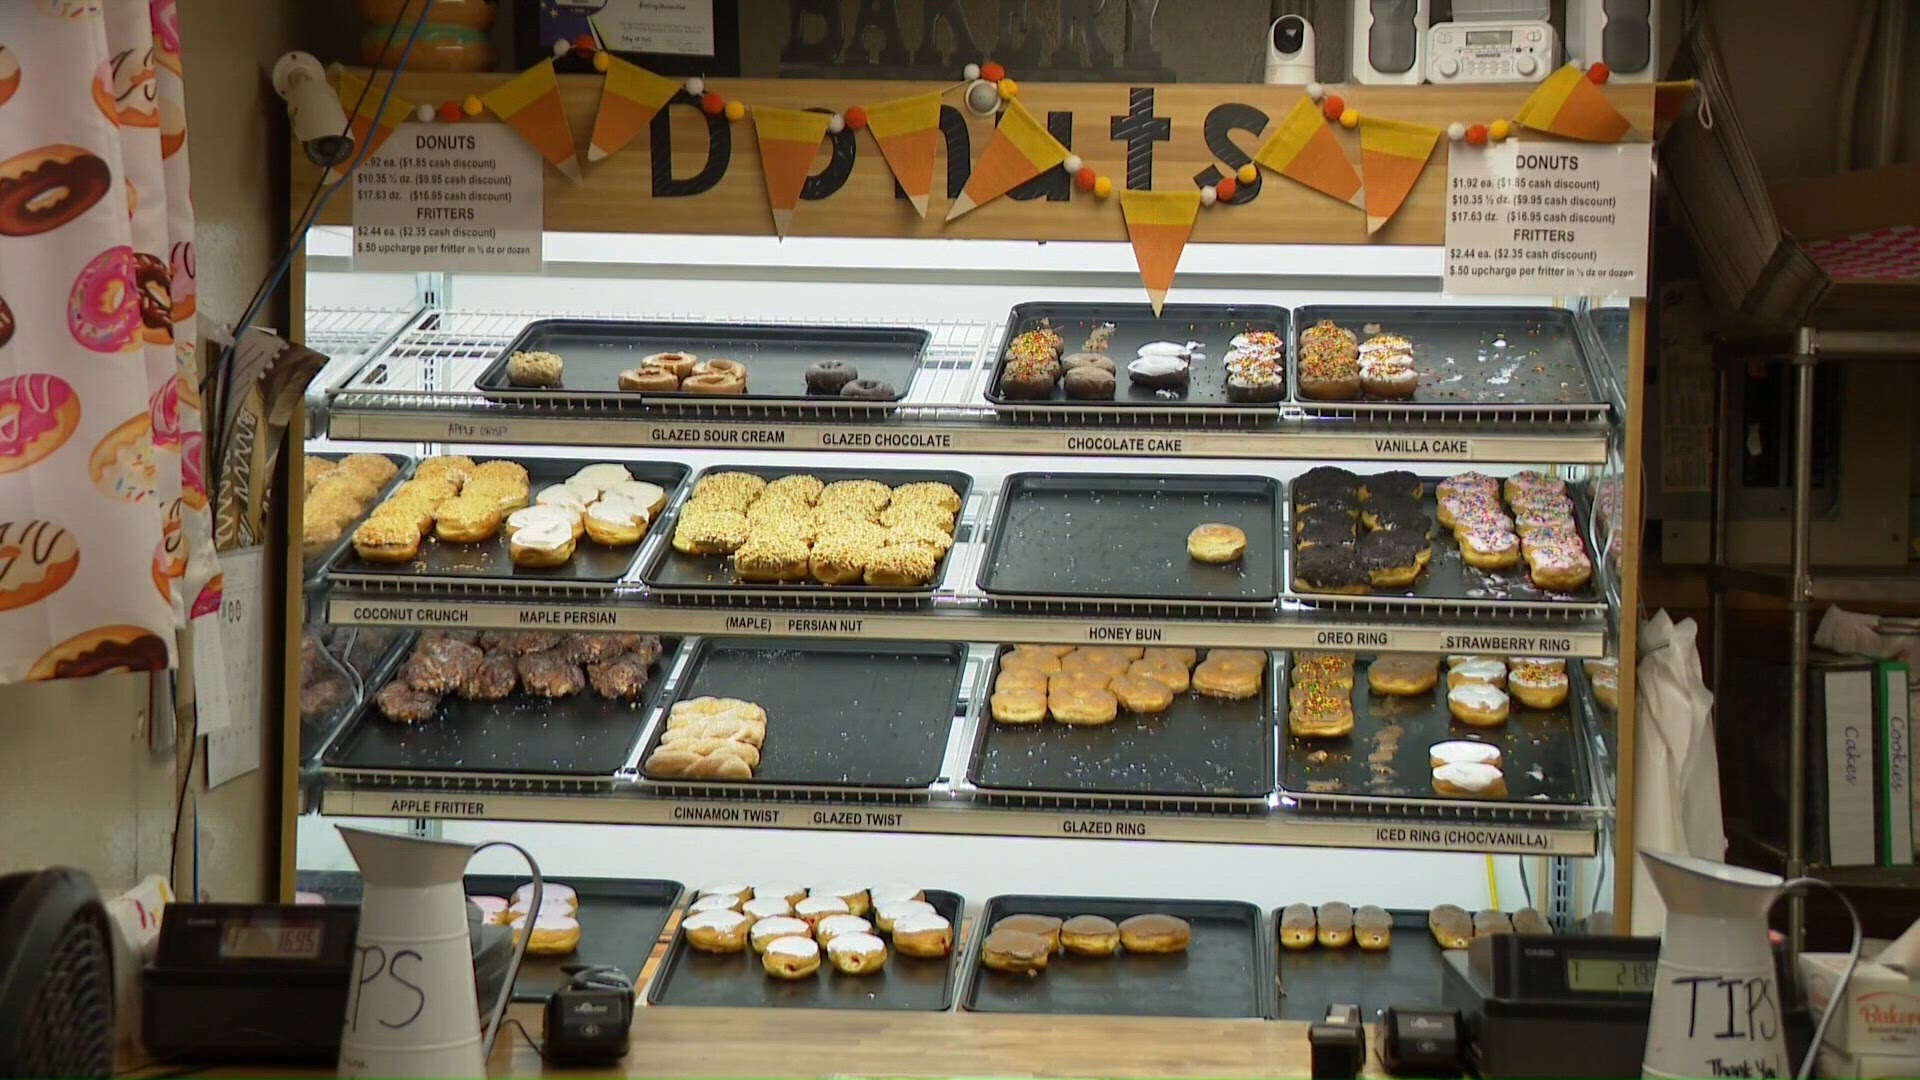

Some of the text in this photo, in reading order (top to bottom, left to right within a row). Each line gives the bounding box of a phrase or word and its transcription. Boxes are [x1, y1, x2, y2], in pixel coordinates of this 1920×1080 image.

[416, 135, 475, 150] DONUTS
[384, 159, 397, 167] ea.
[400, 157, 427, 169] ($1.85
[429, 157, 451, 168] cash
[453, 158, 496, 170] discount)
[1516, 154, 1579, 171] DONUTS
[357, 173, 387, 184] $10.35
[399, 174, 413, 184] dz.
[415, 174, 443, 187] ($9.95
[444, 174, 466, 185] cash
[468, 175, 512, 187] discount)
[1453, 177, 1478, 188] $1.92
[1480, 178, 1494, 188] ea.
[1528, 178, 1551, 189] cash
[1554, 179, 1600, 191] discount)
[357, 190, 387, 200] $17.63
[410, 191, 443, 203] ($16.95
[444, 191, 466, 201] cash
[468, 191, 512, 203] discount)
[1452, 195, 1483, 205] $10.35
[1513, 195, 1542, 208] ($9.95
[1544, 196, 1567, 206] cash
[1570, 196, 1616, 208] discount)
[417, 207, 475, 220] FRITTERS
[1451, 211, 1482, 222] $17.63
[1506, 212, 1541, 224] ($16.95
[1543, 212, 1567, 223] cash
[1569, 213, 1615, 225] discount)
[357, 226, 381, 237] $2.44
[400, 227, 427, 239] ($2.35
[429, 227, 451, 237] cash
[453, 228, 496, 240] discount)
[1513, 229, 1575, 242] FRITTERS
[378, 243, 421, 256] upcharge
[424, 245, 438, 256] per
[441, 244, 466, 254] fritter
[468, 246, 475, 254] in
[486, 246, 495, 254] dz
[507, 246, 531, 255] dozen
[1450, 248, 1597, 262] $2.44 ea. ($2.35 cash discount)
[1471, 266, 1516, 278] upcharge
[1519, 268, 1535, 278] per
[1537, 266, 1564, 276] fritter
[1566, 268, 1575, 276] in
[1586, 268, 1596, 277] dz
[1597, 269, 1606, 277] or
[1608, 268, 1634, 278] dozen
[448, 423, 475, 437] APPLE
[652, 428, 785, 443] GLAZED SOUR CREAM
[822, 433, 950, 447] GLAZED CHOCOLATE
[1068, 437, 1182, 452] CHOCOLATE CAKE
[1375, 440, 1468, 453] VANILLA CAKE
[354, 607, 468, 622] COCONUT CRUNCH
[519, 610, 617, 624] MAPLE PERSIAN
[725, 616, 863, 632] (MAPLE) PERSIAN NUT
[1089, 627, 1161, 640] HONEY BUN
[1317, 631, 1388, 645] OREO RING
[1446, 635, 1570, 651] STRAWBERRY RING
[1844, 726, 1861, 785] Cakes
[1890, 716, 1907, 791] Cookies
[391, 800, 485, 814] APPLE FRITTER
[674, 806, 780, 823] CINNAMON TWIST
[813, 811, 903, 826] GLAZED TWIST
[1063, 820, 1146, 835] GLAZED RING
[1376, 828, 1548, 849] ICED RING (CHOC/VANILLA)
[346, 945, 425, 1033] PS
[1672, 976, 1777, 1042] TIPS
